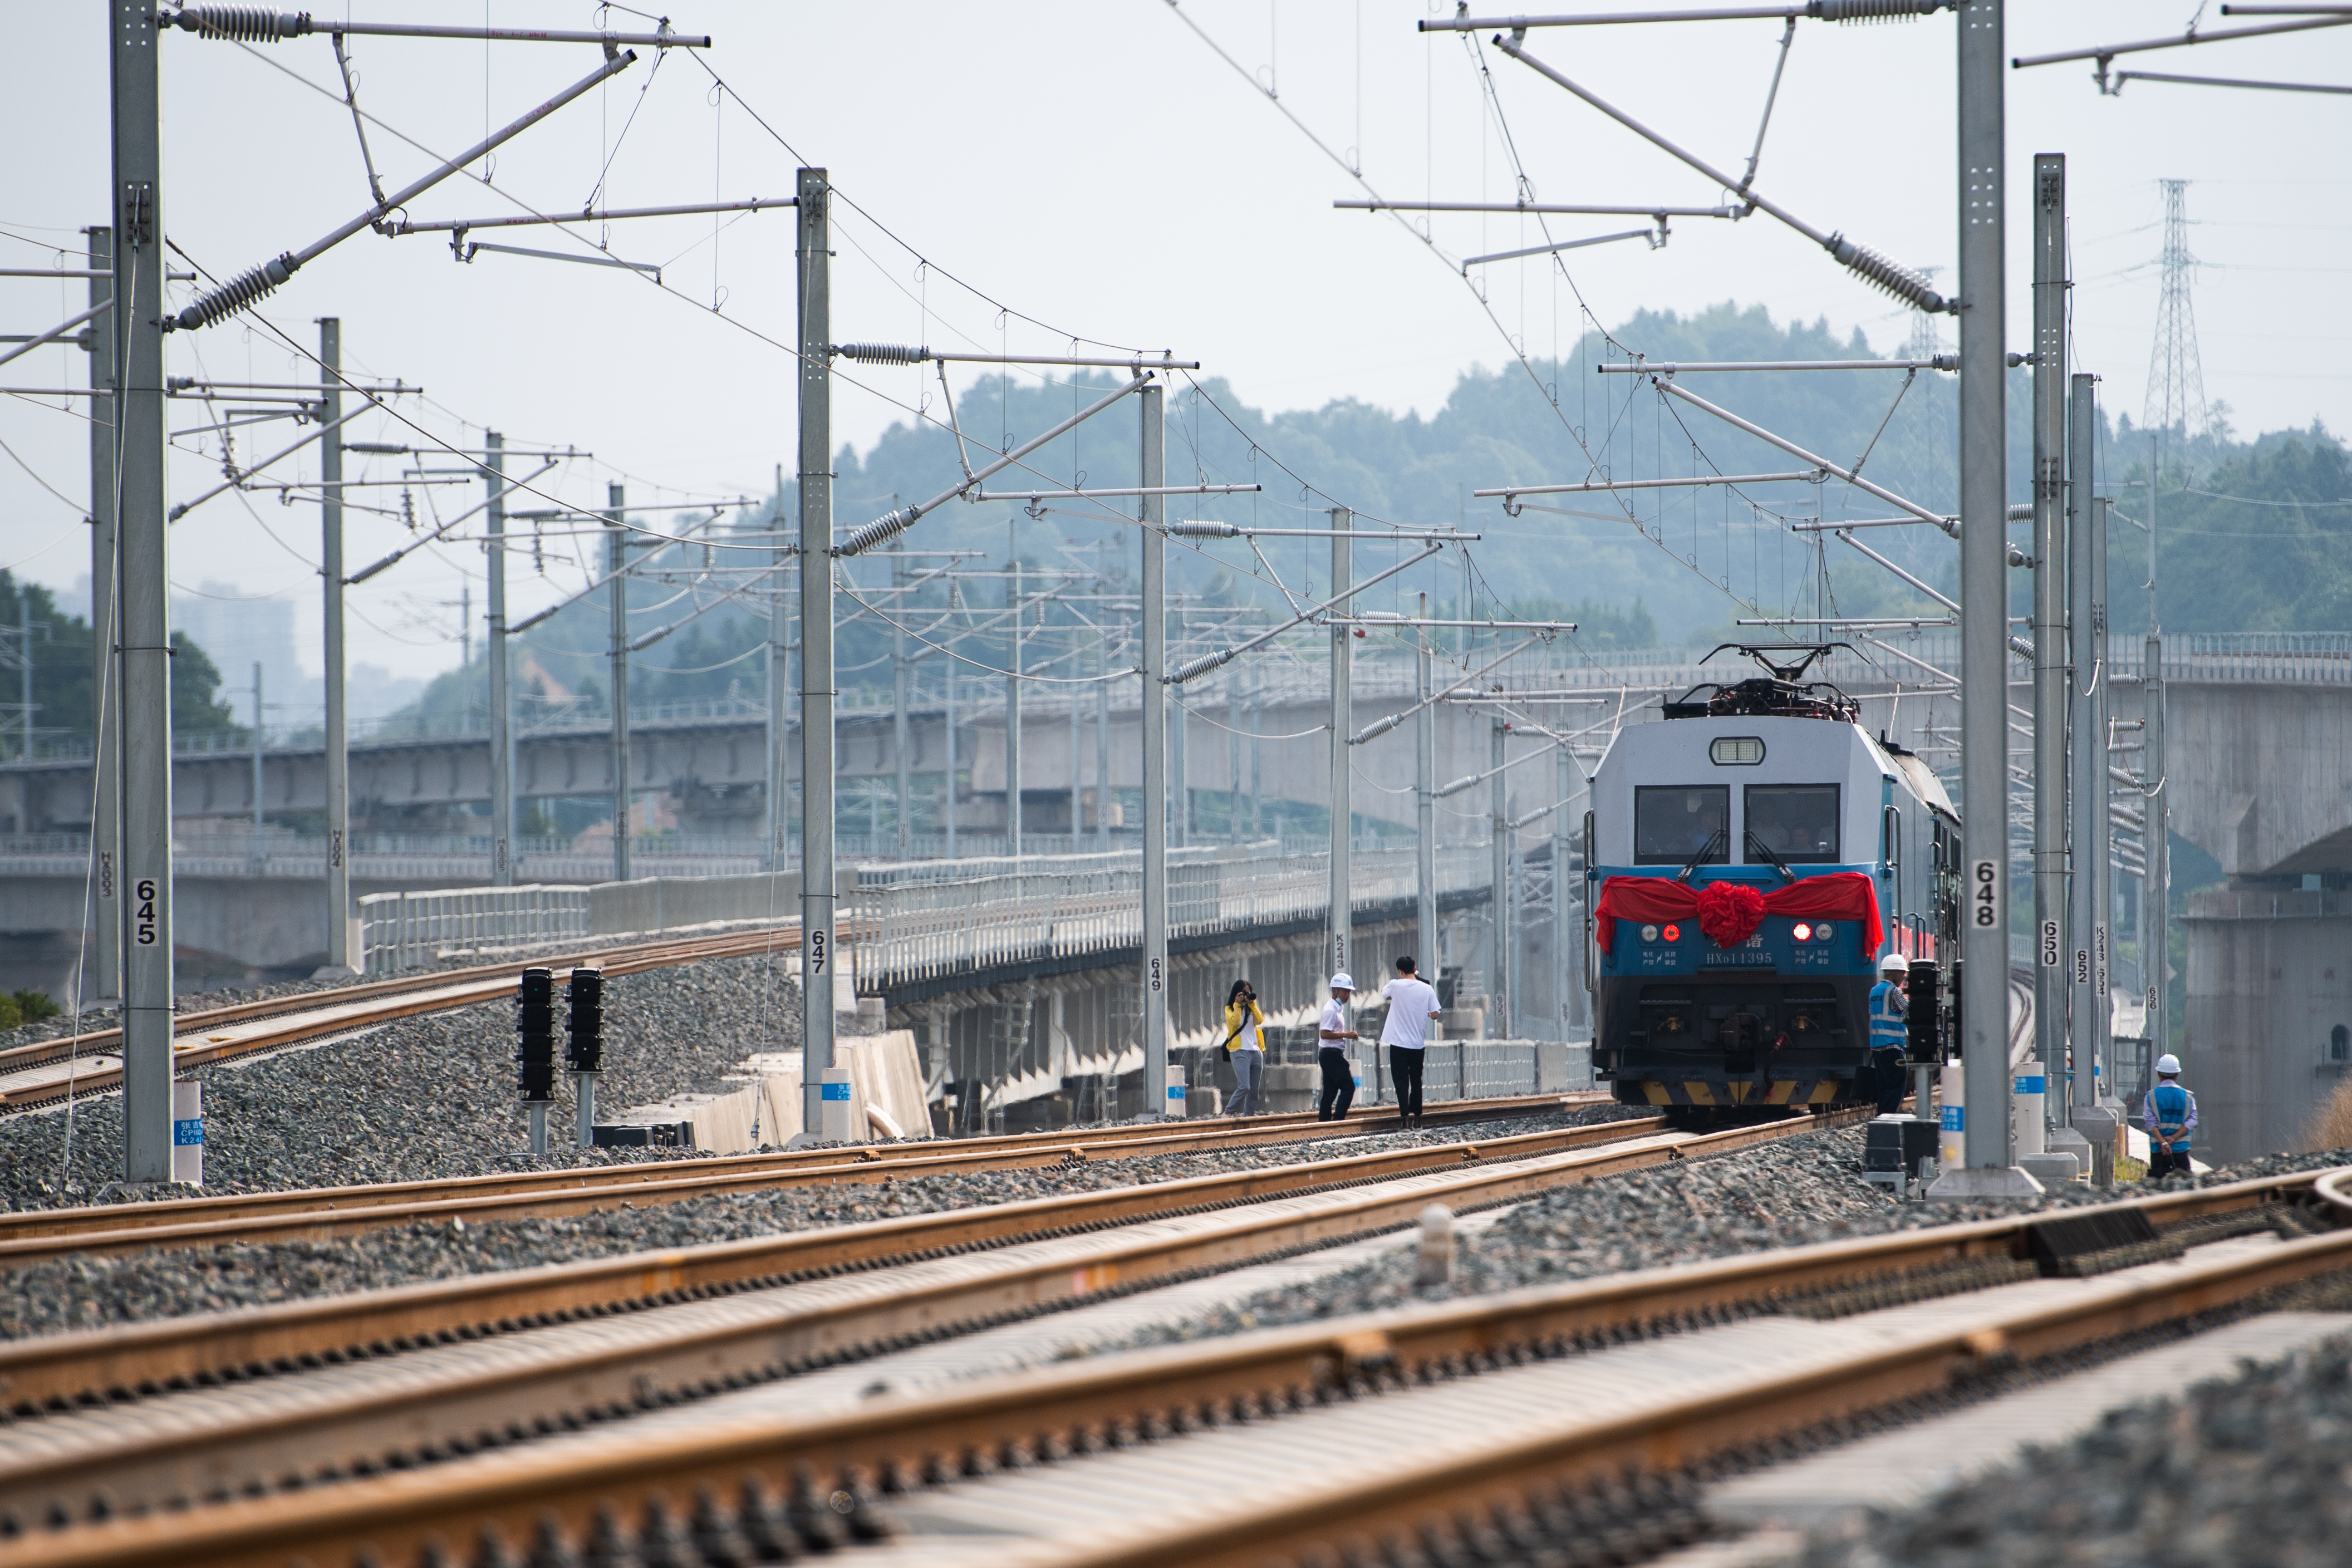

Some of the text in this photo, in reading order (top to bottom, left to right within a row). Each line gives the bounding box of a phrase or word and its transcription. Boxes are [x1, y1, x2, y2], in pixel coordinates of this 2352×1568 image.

[137, 880, 156, 945] 645
[1977, 861, 1994, 926] 648
[812, 931, 824, 974] 647
[1336, 933, 1344, 969] K243
[2044, 922, 2057, 965] 650
[1151, 959, 1161, 991] 649
[2078, 951, 2086, 983] 652
